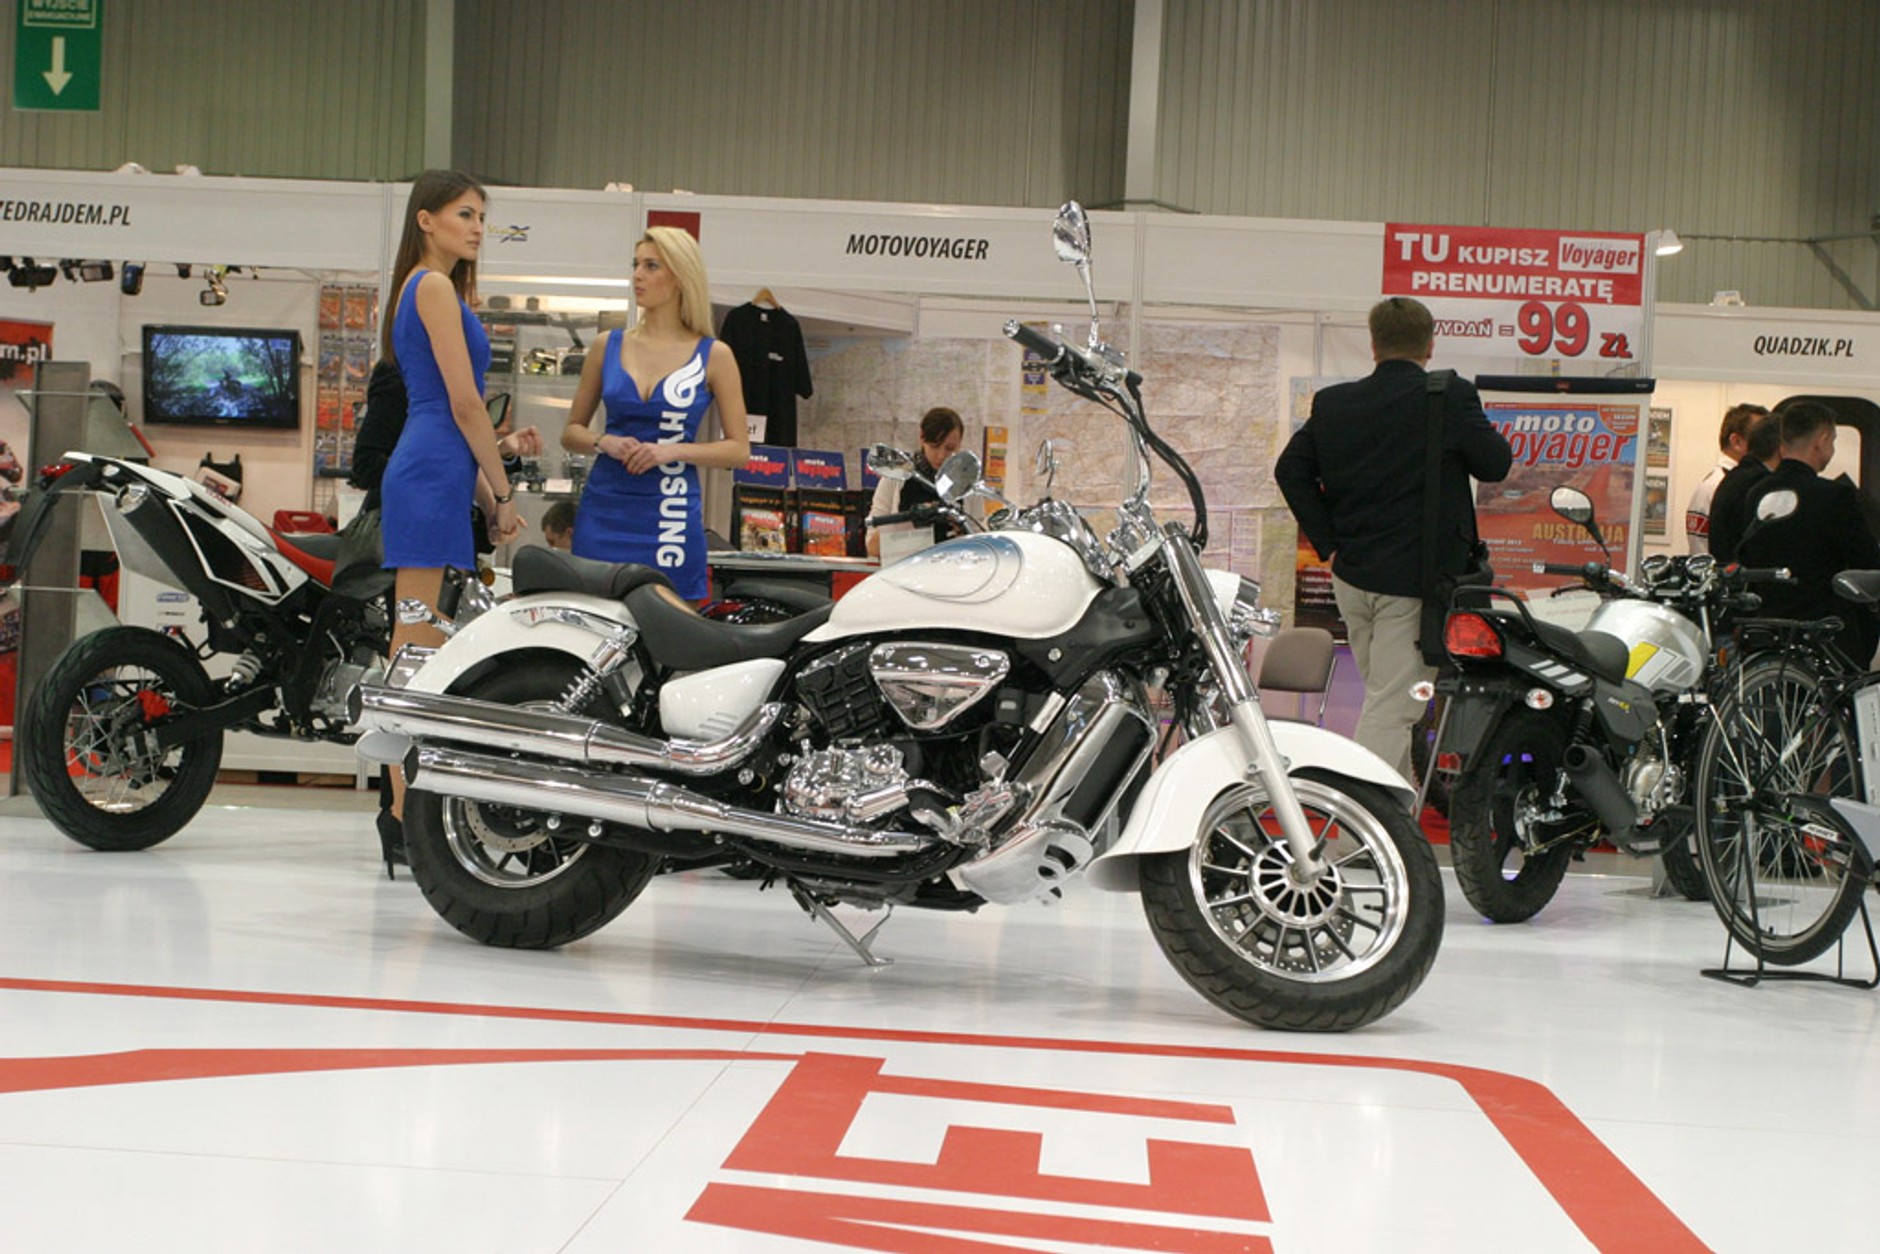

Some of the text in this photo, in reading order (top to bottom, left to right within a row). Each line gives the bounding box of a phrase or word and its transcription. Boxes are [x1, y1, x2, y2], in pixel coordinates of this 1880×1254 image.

[0, 200, 131, 226] EDRAJDEM.PL
[846, 234, 989, 260] MOTOVOYAGER
[1394, 232, 1637, 269] TU KUPISZ Voyager
[1411, 271, 1613, 303] PRENUMERATĘ
[1754, 335, 1854, 357] QUADZIK.PL
[1514, 413, 1595, 432] moto
